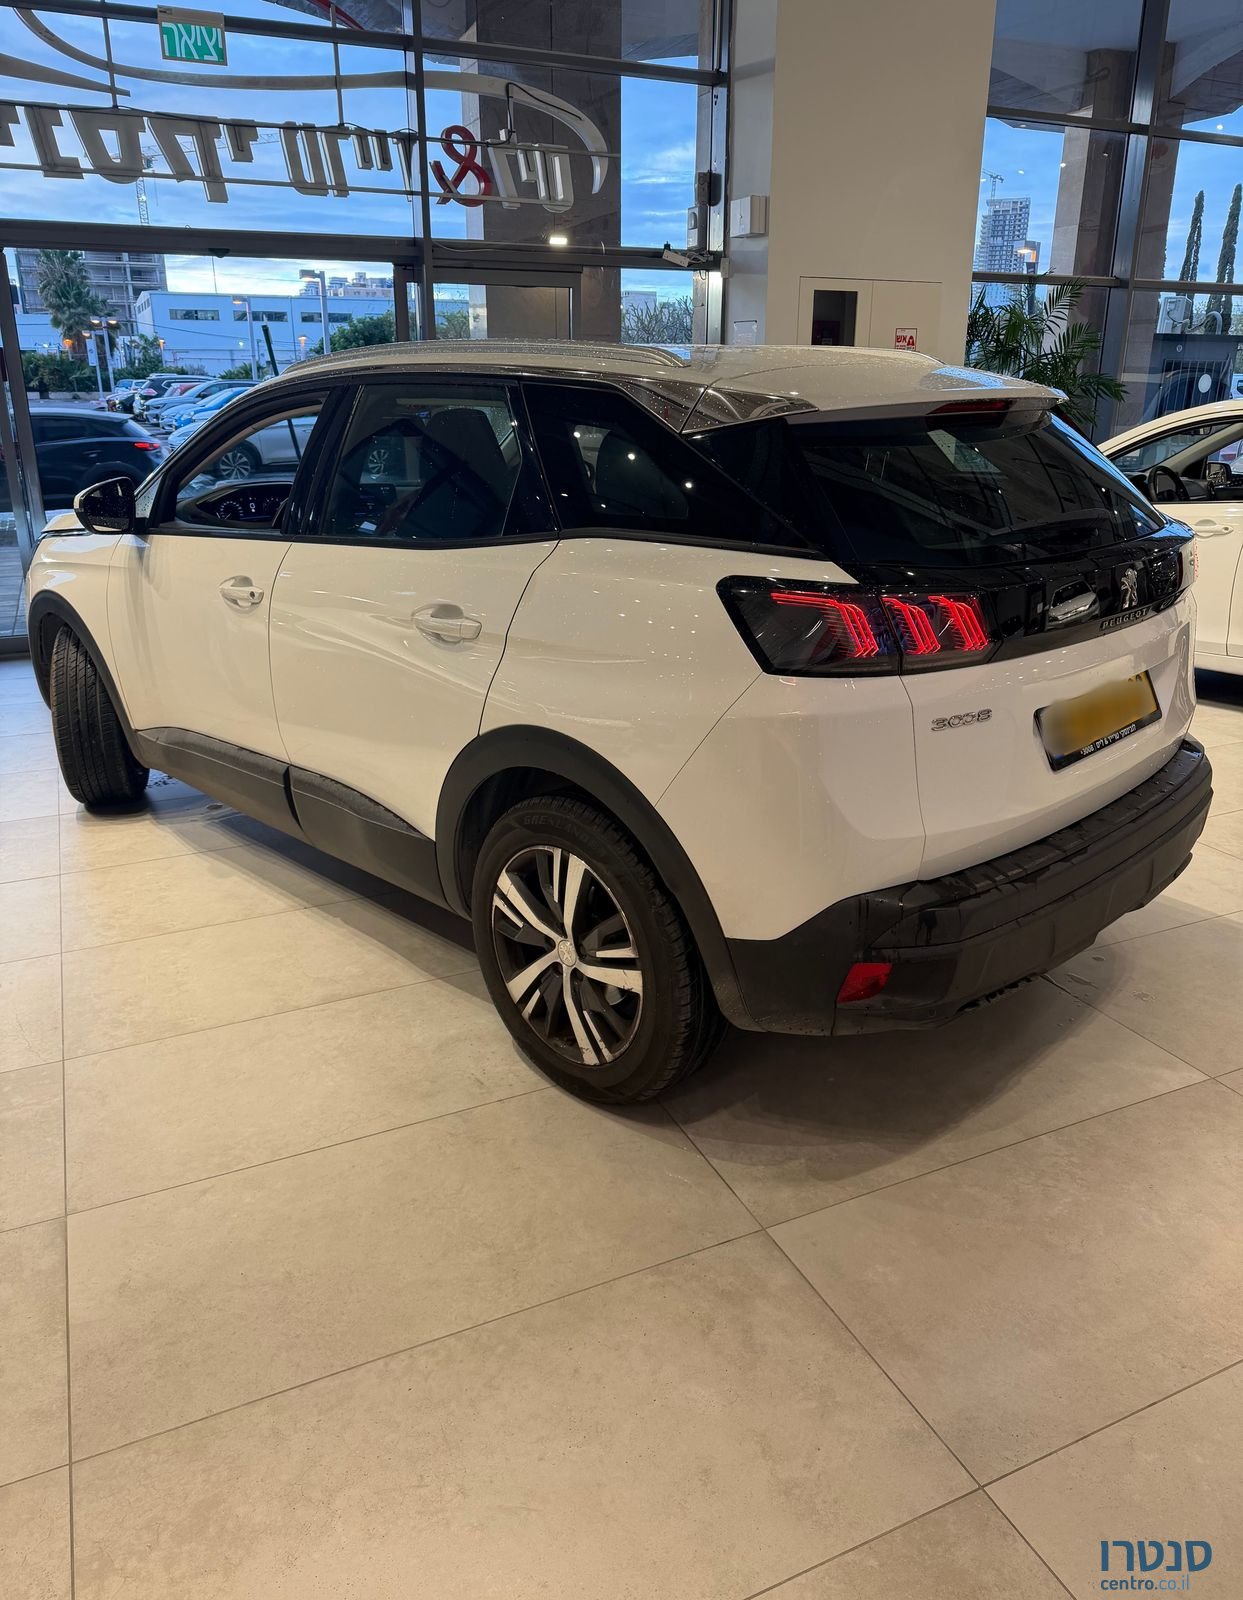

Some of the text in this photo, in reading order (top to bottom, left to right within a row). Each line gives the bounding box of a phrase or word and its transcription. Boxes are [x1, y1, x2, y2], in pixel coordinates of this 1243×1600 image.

[161, 22, 223, 61] יציאה
[1102, 607, 1147, 630] PEUGEOT
[931, 709, 992, 731] 3008
